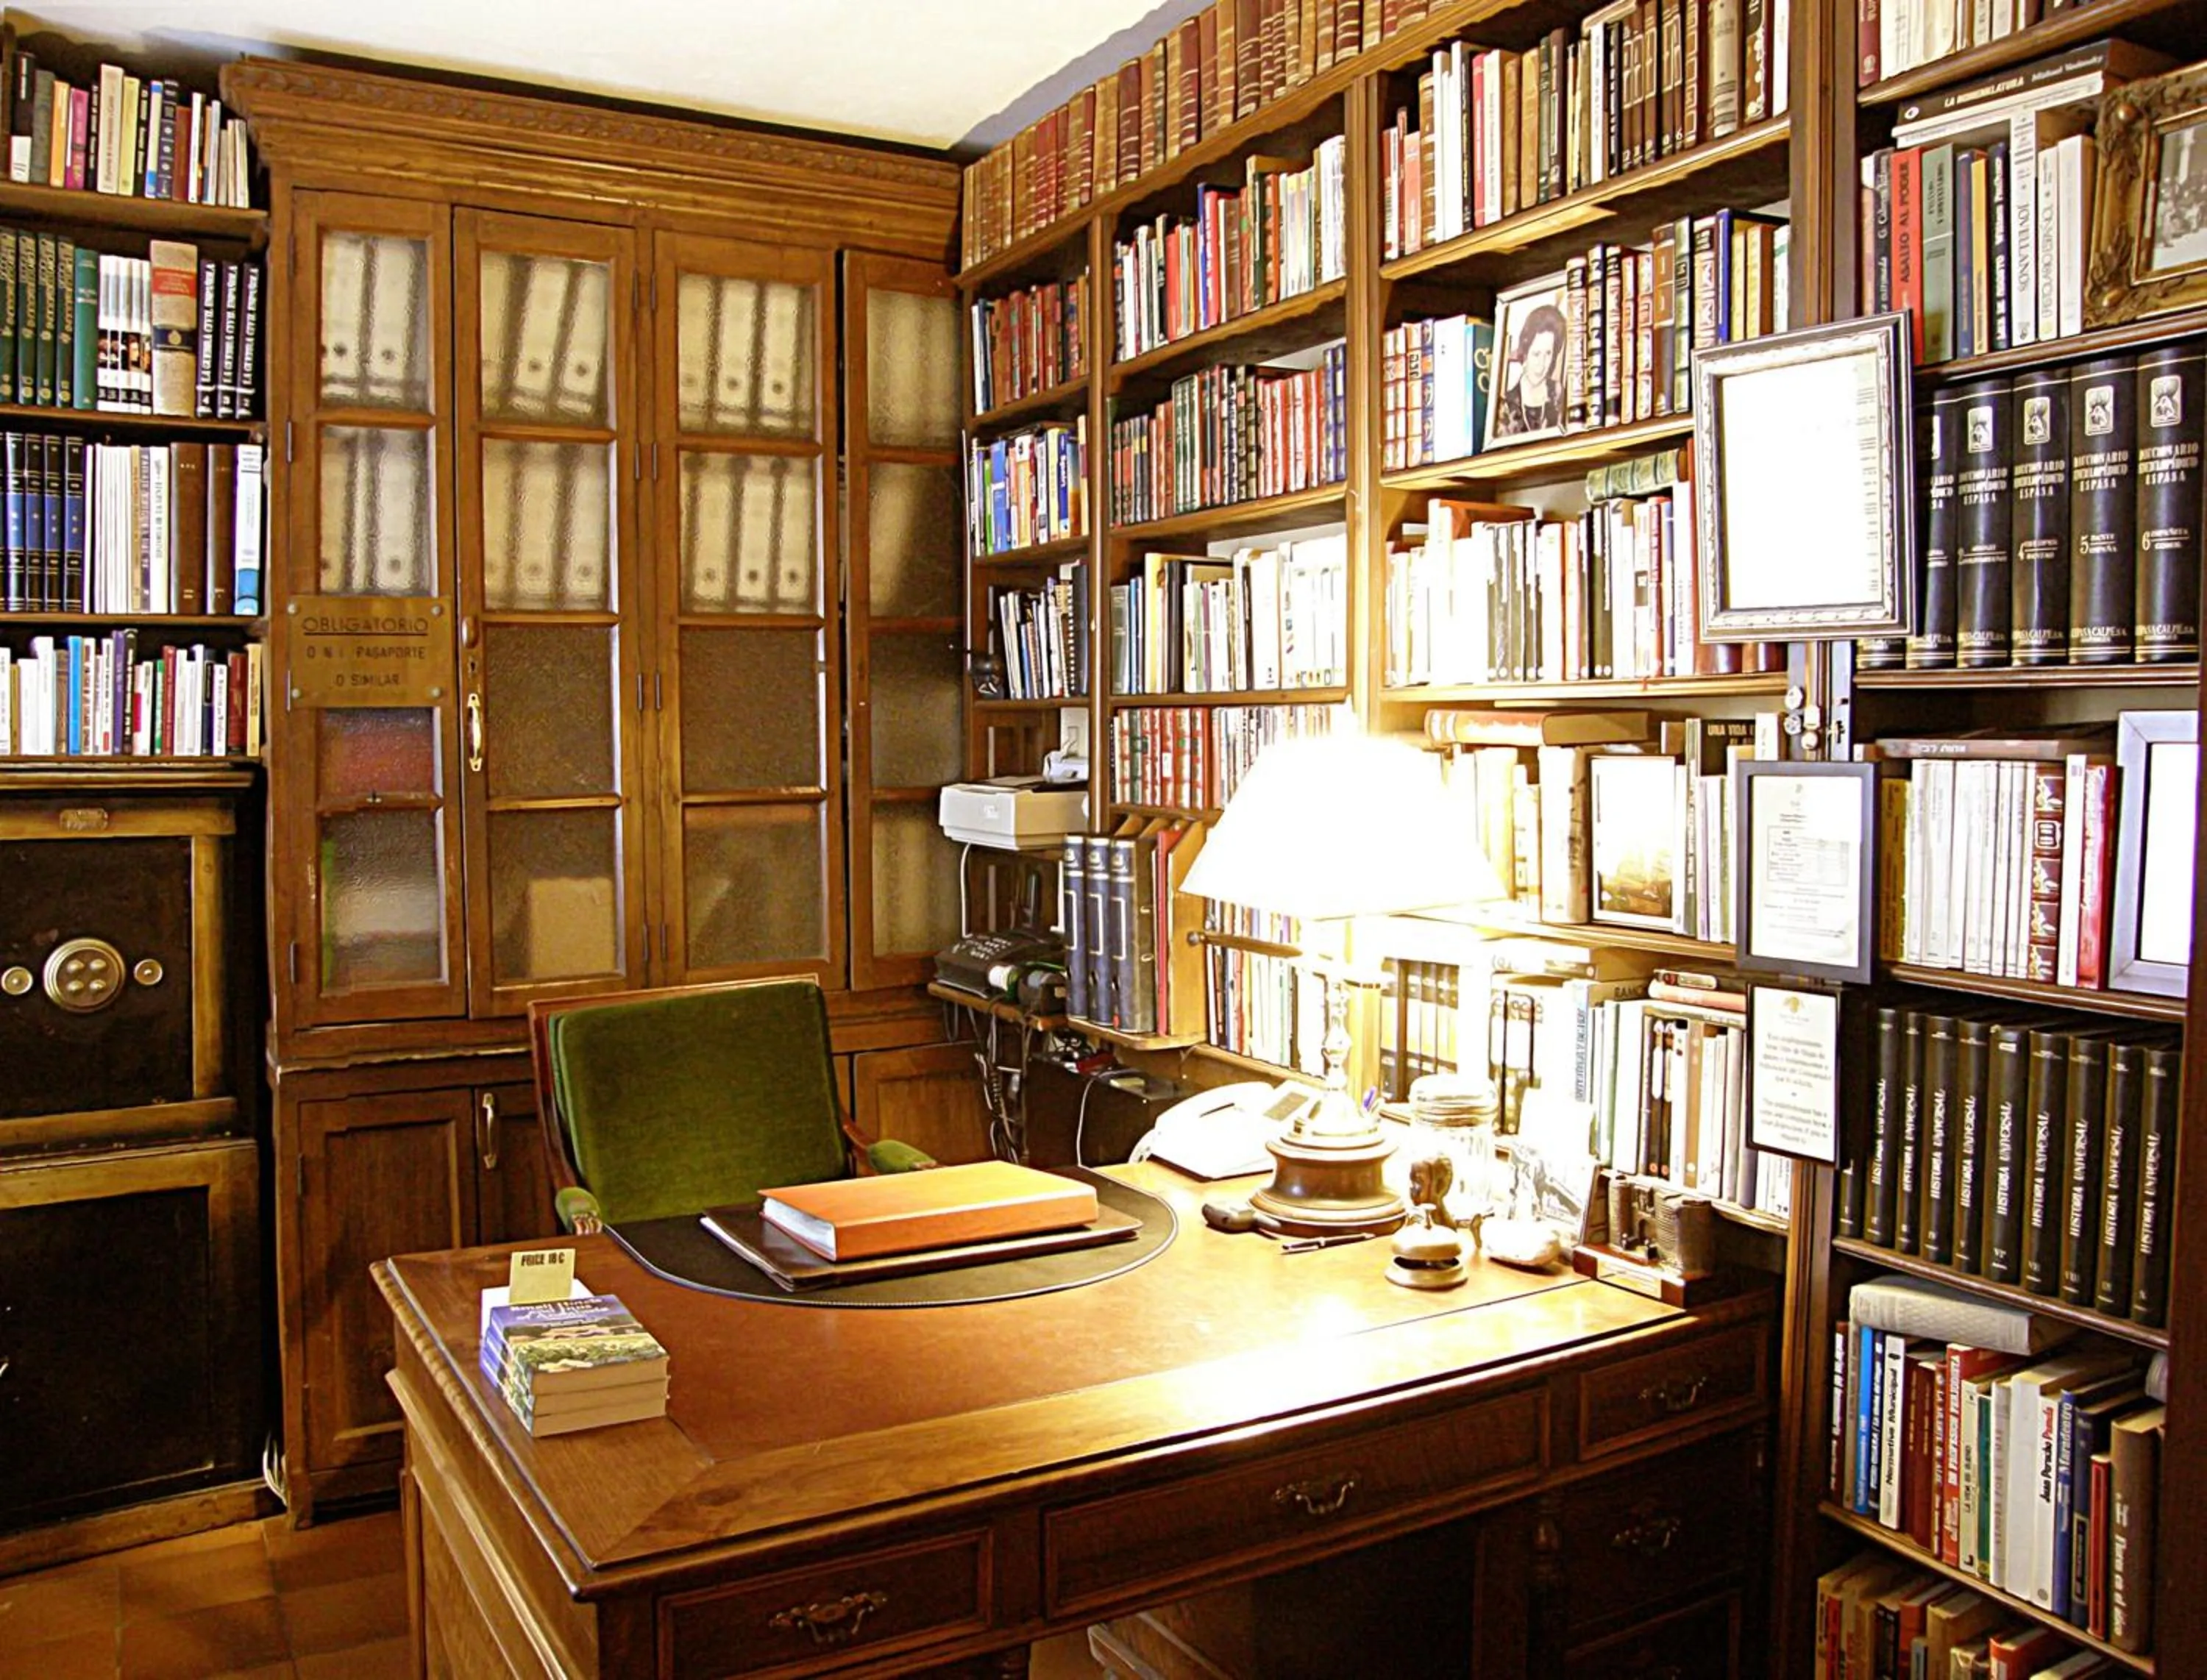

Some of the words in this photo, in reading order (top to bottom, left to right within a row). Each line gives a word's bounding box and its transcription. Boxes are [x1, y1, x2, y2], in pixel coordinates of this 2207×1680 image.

[1899, 207, 1910, 227] AL
[1899, 233, 1910, 283] ASALTO
[2080, 535, 2089, 554] 5
[2142, 531, 2150, 551] 6
[303, 616, 428, 632] OBLIGATORIO
[356, 646, 425, 658] PASAPORTE
[351, 673, 401, 686] SIMILAR
[1933, 1089, 1946, 1147] UNIVERSAL
[1963, 1095, 1976, 1154] UNIVERSAL
[1999, 1101, 2012, 1161] UNIVERSAL
[2035, 1111, 2050, 1172] UNIVERSAL
[1903, 1145, 1913, 1192] HISTORIA
[2073, 1119, 2088, 1181] UNIVERSAL
[2108, 1125, 2123, 1189] UNIVERSAL
[2144, 1131, 2161, 1195] UNIVERSAL
[1930, 1152, 1942, 1199] HISTORIA
[1960, 1158, 1973, 1207] HISTORIA
[1997, 1167, 2009, 1216] HISTORIA
[2032, 1178, 2045, 1228] HISTORIA
[2069, 1186, 2083, 1237] HISTORIA
[2105, 1195, 2118, 1247] HISTORIA
[2140, 1201, 2155, 1254] HISTORIA
[521, 1253, 545, 1266] PRICE
